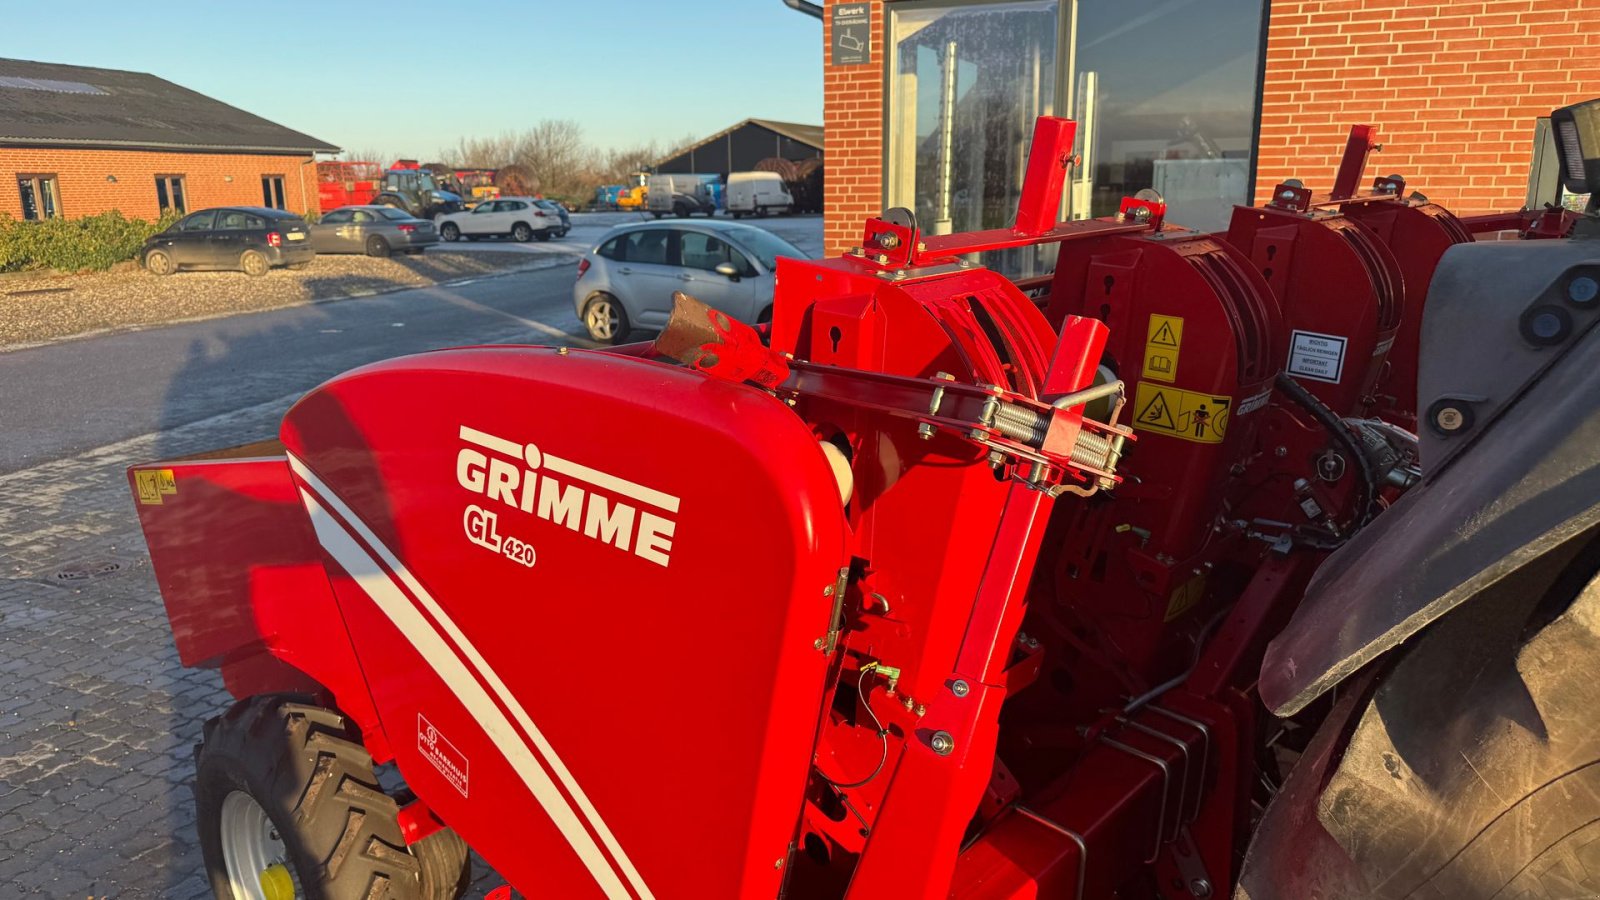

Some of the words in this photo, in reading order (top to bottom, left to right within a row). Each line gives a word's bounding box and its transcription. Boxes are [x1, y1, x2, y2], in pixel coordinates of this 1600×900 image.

[463, 504, 502, 554] GL
[502, 536, 537, 568] 420
[420, 732, 435, 750] OTTO
[435, 747, 467, 783] BARKHUIS
